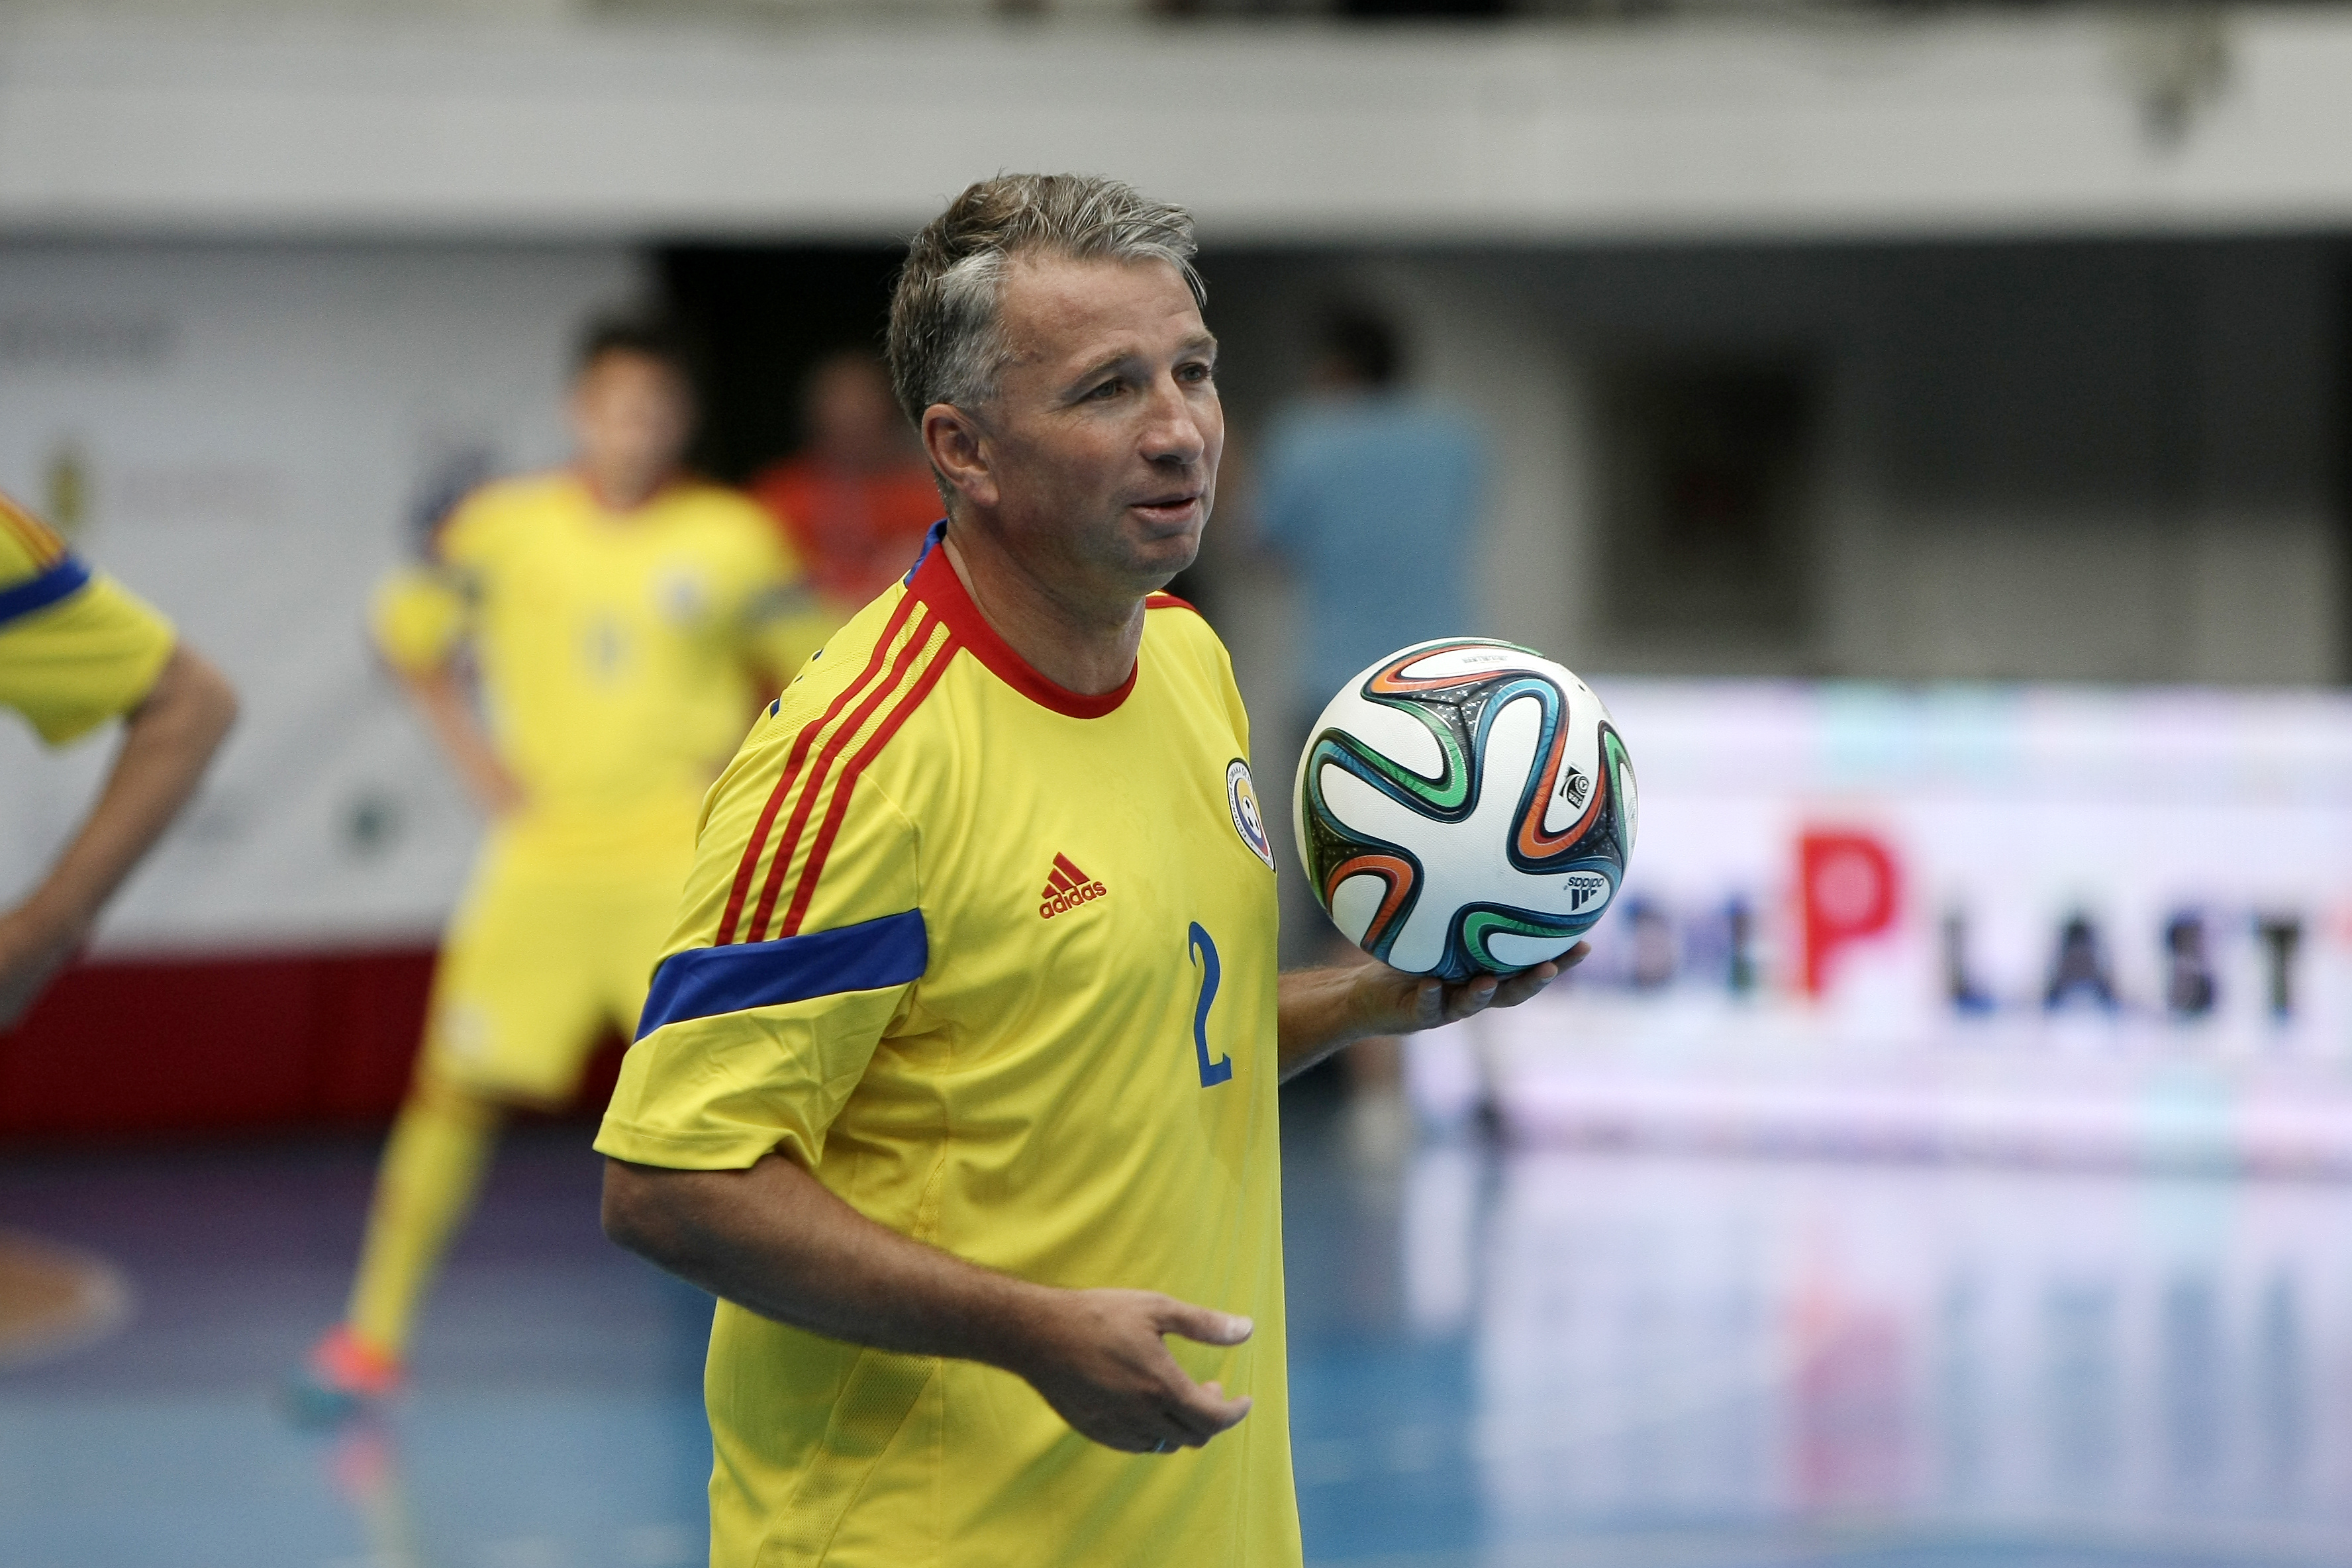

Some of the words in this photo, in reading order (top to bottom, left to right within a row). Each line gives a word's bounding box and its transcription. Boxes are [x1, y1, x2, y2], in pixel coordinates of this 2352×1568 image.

[1039, 881, 1106, 919] adidas
[1567, 877, 1604, 890] adidas
[1188, 921, 1232, 1088] 2
